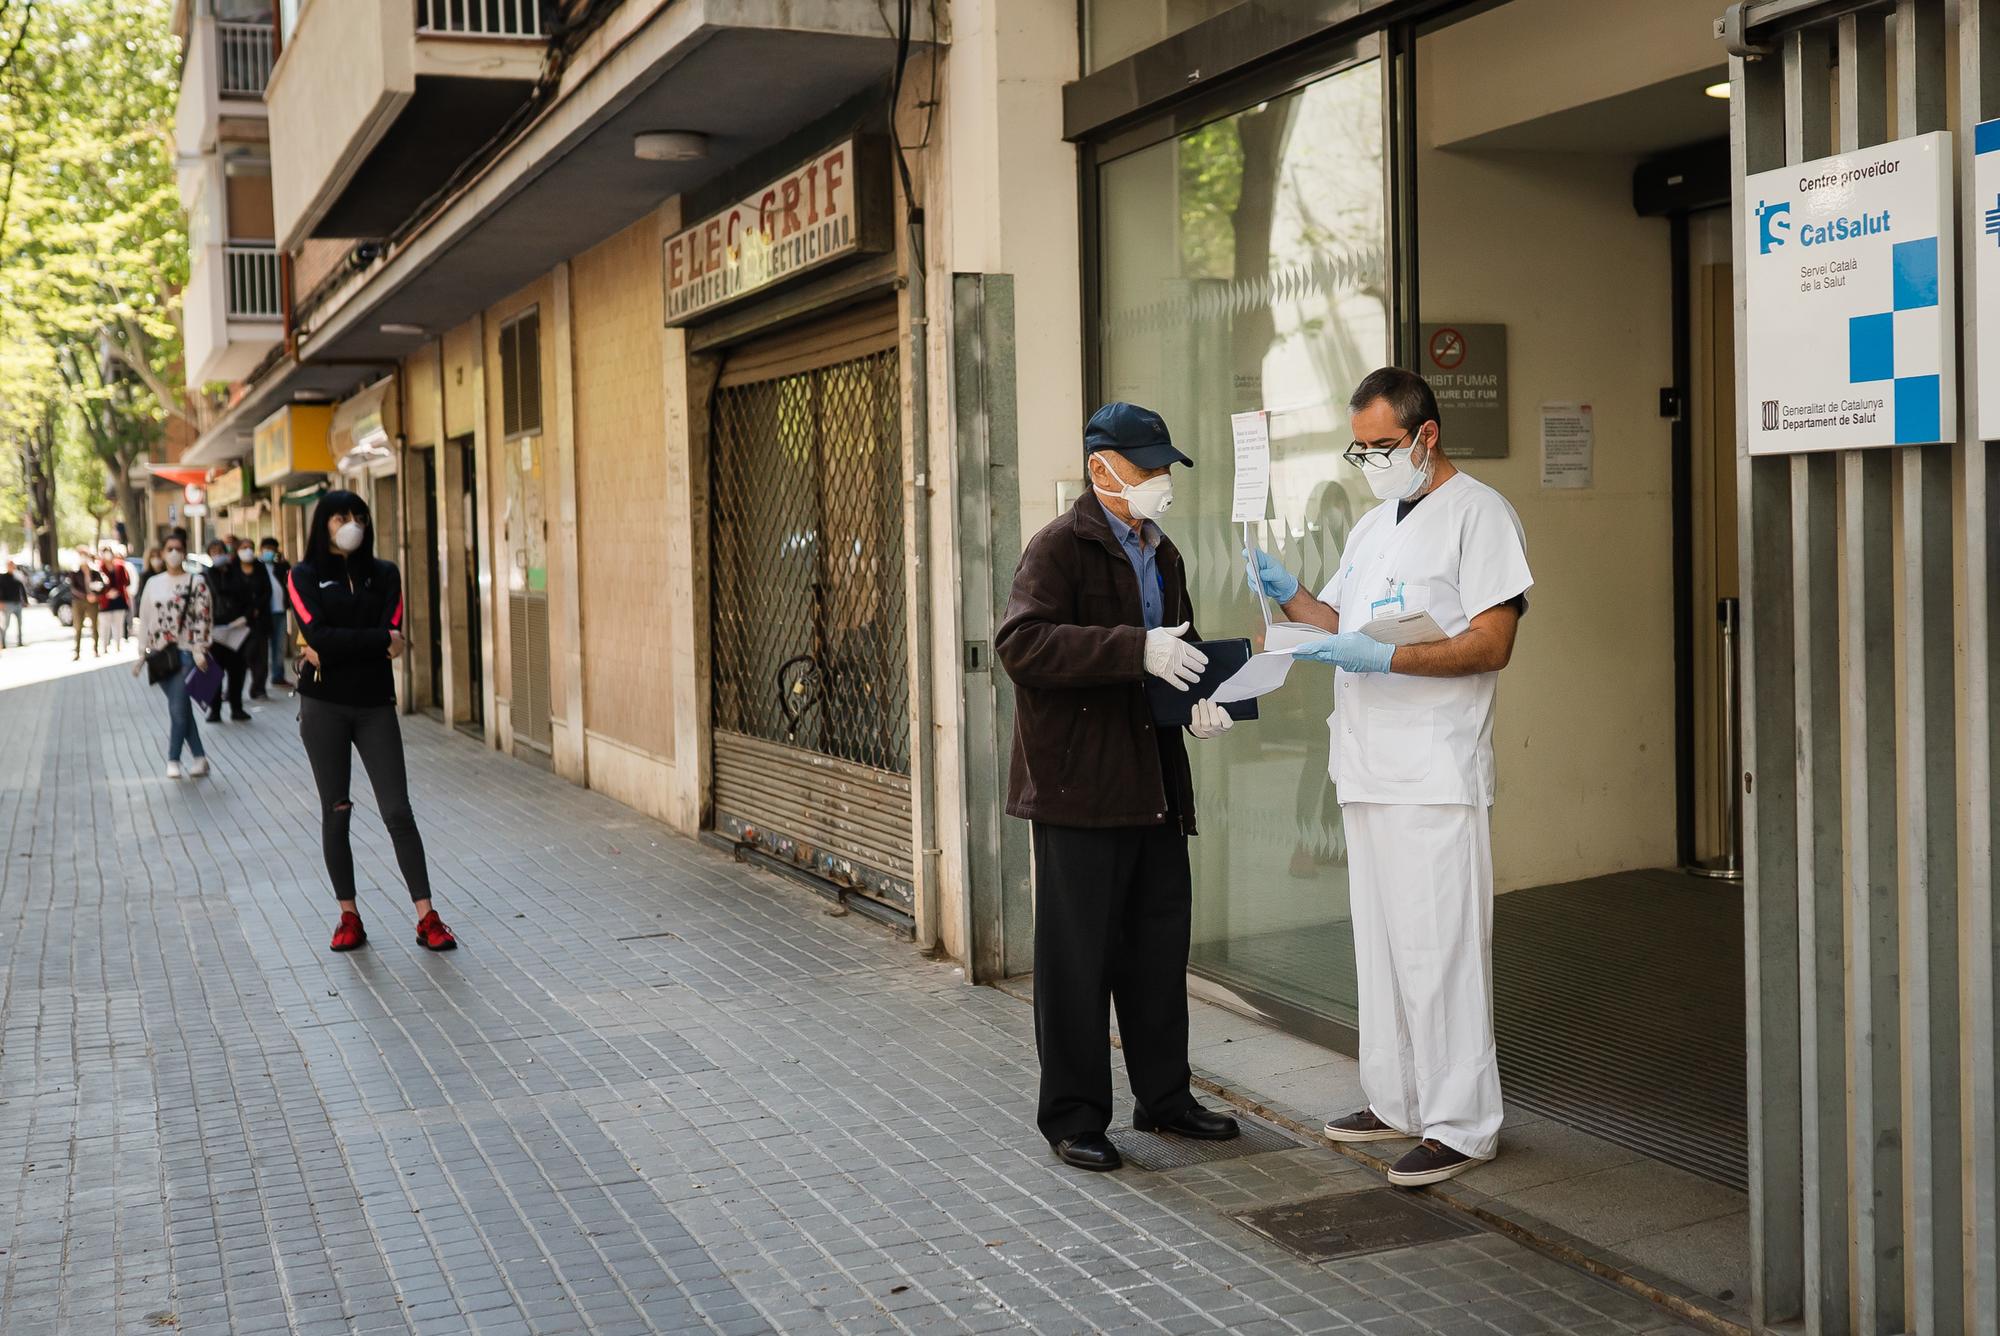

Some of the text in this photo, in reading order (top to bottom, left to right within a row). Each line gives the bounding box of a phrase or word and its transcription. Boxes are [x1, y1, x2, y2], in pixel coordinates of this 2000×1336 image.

[1799, 160, 1900, 192] Centre proveïdor
[1800, 210, 1891, 247] CatSalut
[1800, 257, 1858, 278] Servei Català
[1800, 276, 1846, 293] de la Salut
[1425, 374, 1497, 386] HIBIT FUMAR
[1434, 390, 1497, 399] LIURE DE FUM
[1782, 398, 1884, 416] Generalitat de Catalunya
[1782, 412, 1876, 431] Departament de Salut
